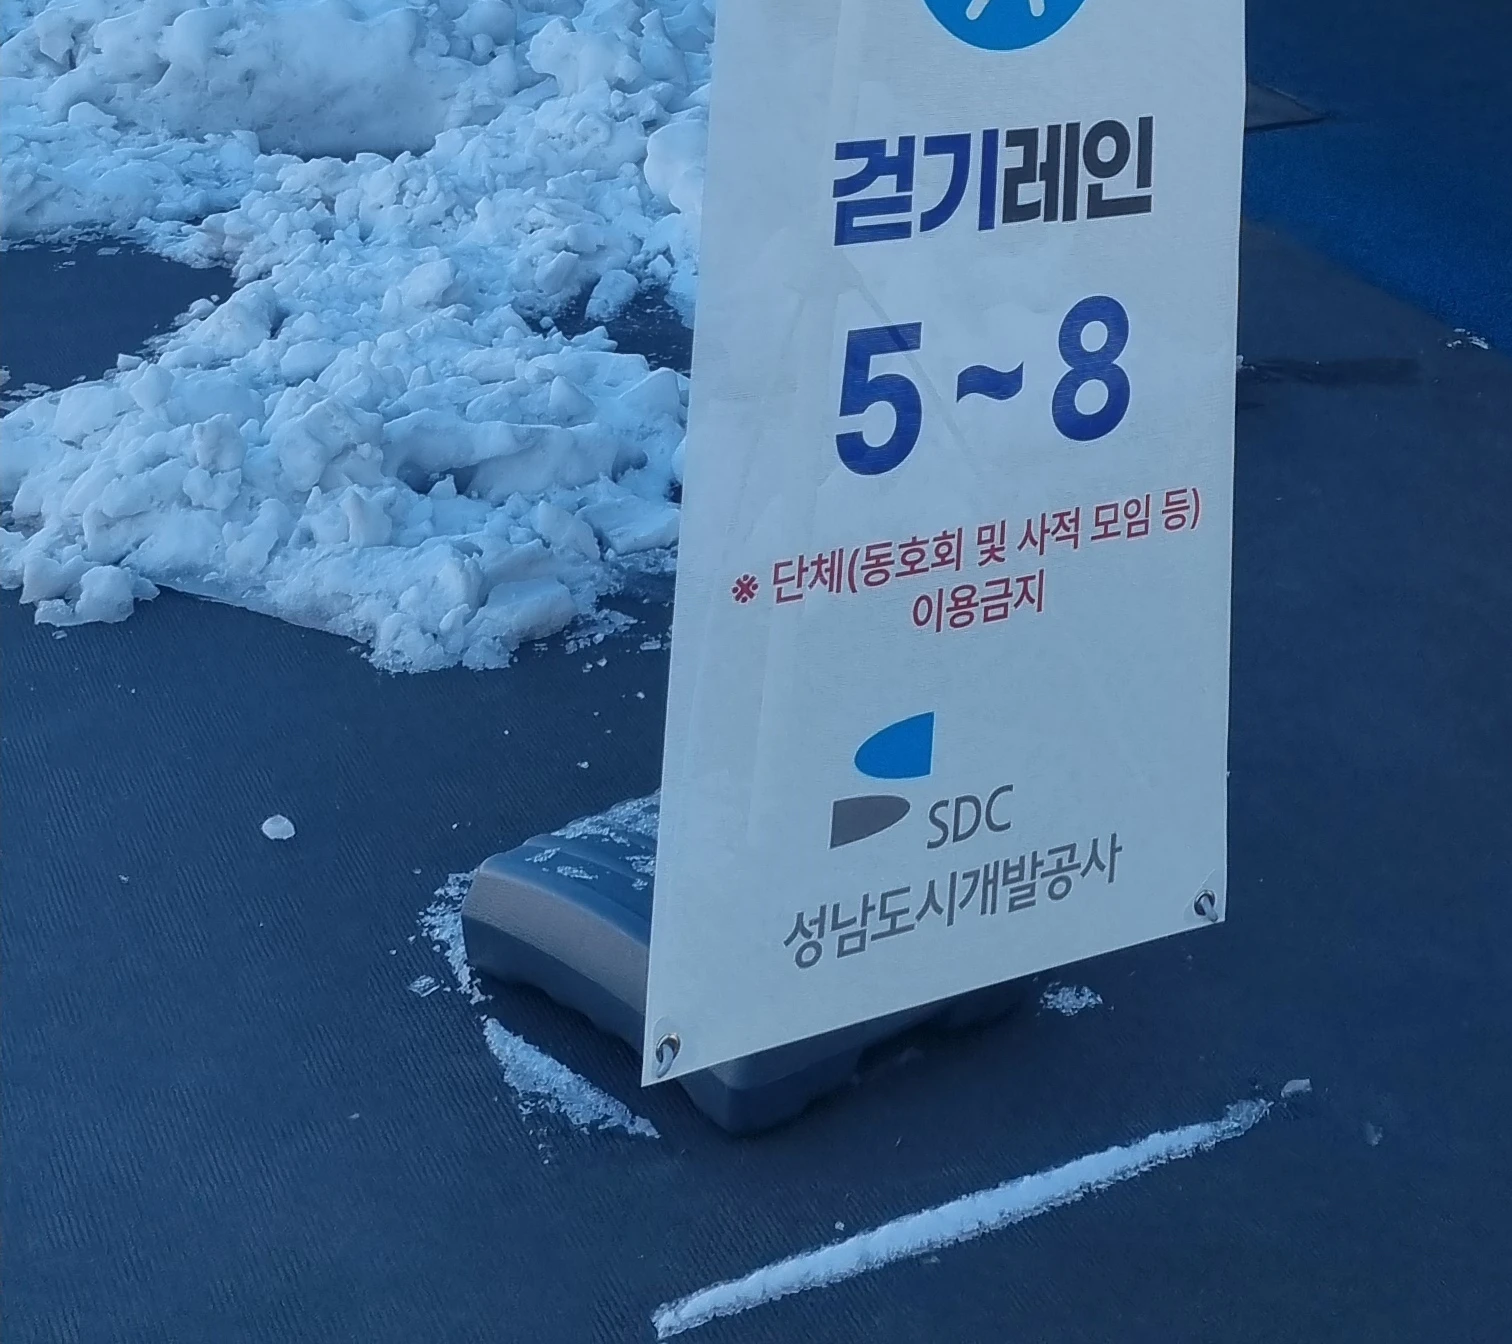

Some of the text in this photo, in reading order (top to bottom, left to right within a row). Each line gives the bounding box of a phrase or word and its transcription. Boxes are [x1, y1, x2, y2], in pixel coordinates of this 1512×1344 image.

[832, 115, 1154, 246] 걷기레인
[976, 519, 1007, 567] 및
[1018, 505, 1082, 557] 사적
[1090, 493, 1153, 542] 모임
[1160, 486, 1202, 533] 등)
[911, 568, 1046, 633] 이용금지
[925, 784, 1014, 849] SDC
[782, 832, 1123, 969] 성남도시개발공사
